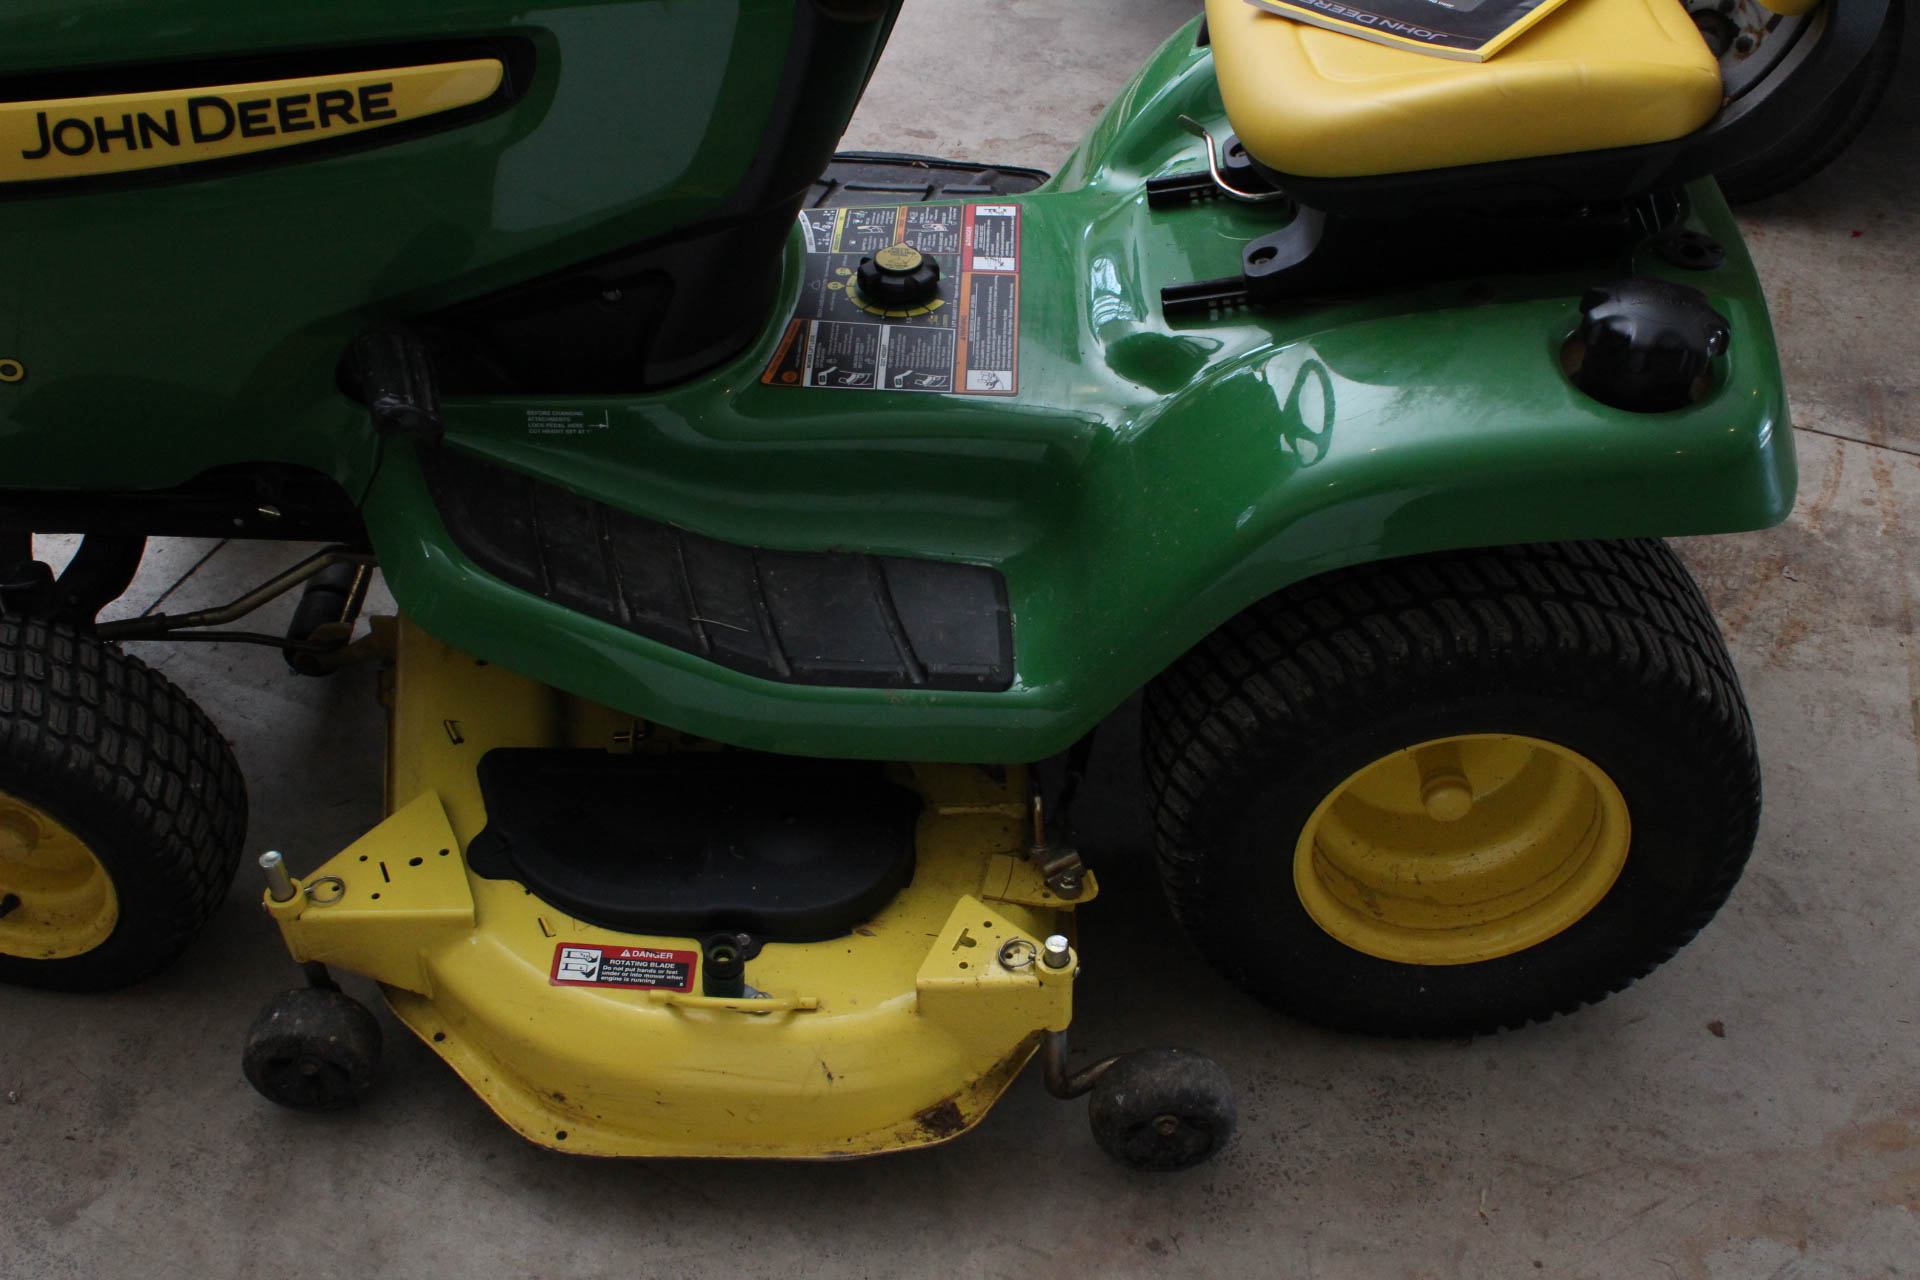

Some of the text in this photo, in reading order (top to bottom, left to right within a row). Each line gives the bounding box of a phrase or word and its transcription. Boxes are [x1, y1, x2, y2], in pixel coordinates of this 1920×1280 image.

[1379, 19, 1449, 41] JOHN
[21, 82, 397, 160] JOHN DEERE
[610, 959, 648, 967] ROTATING
[632, 950, 674, 960] DANGER
